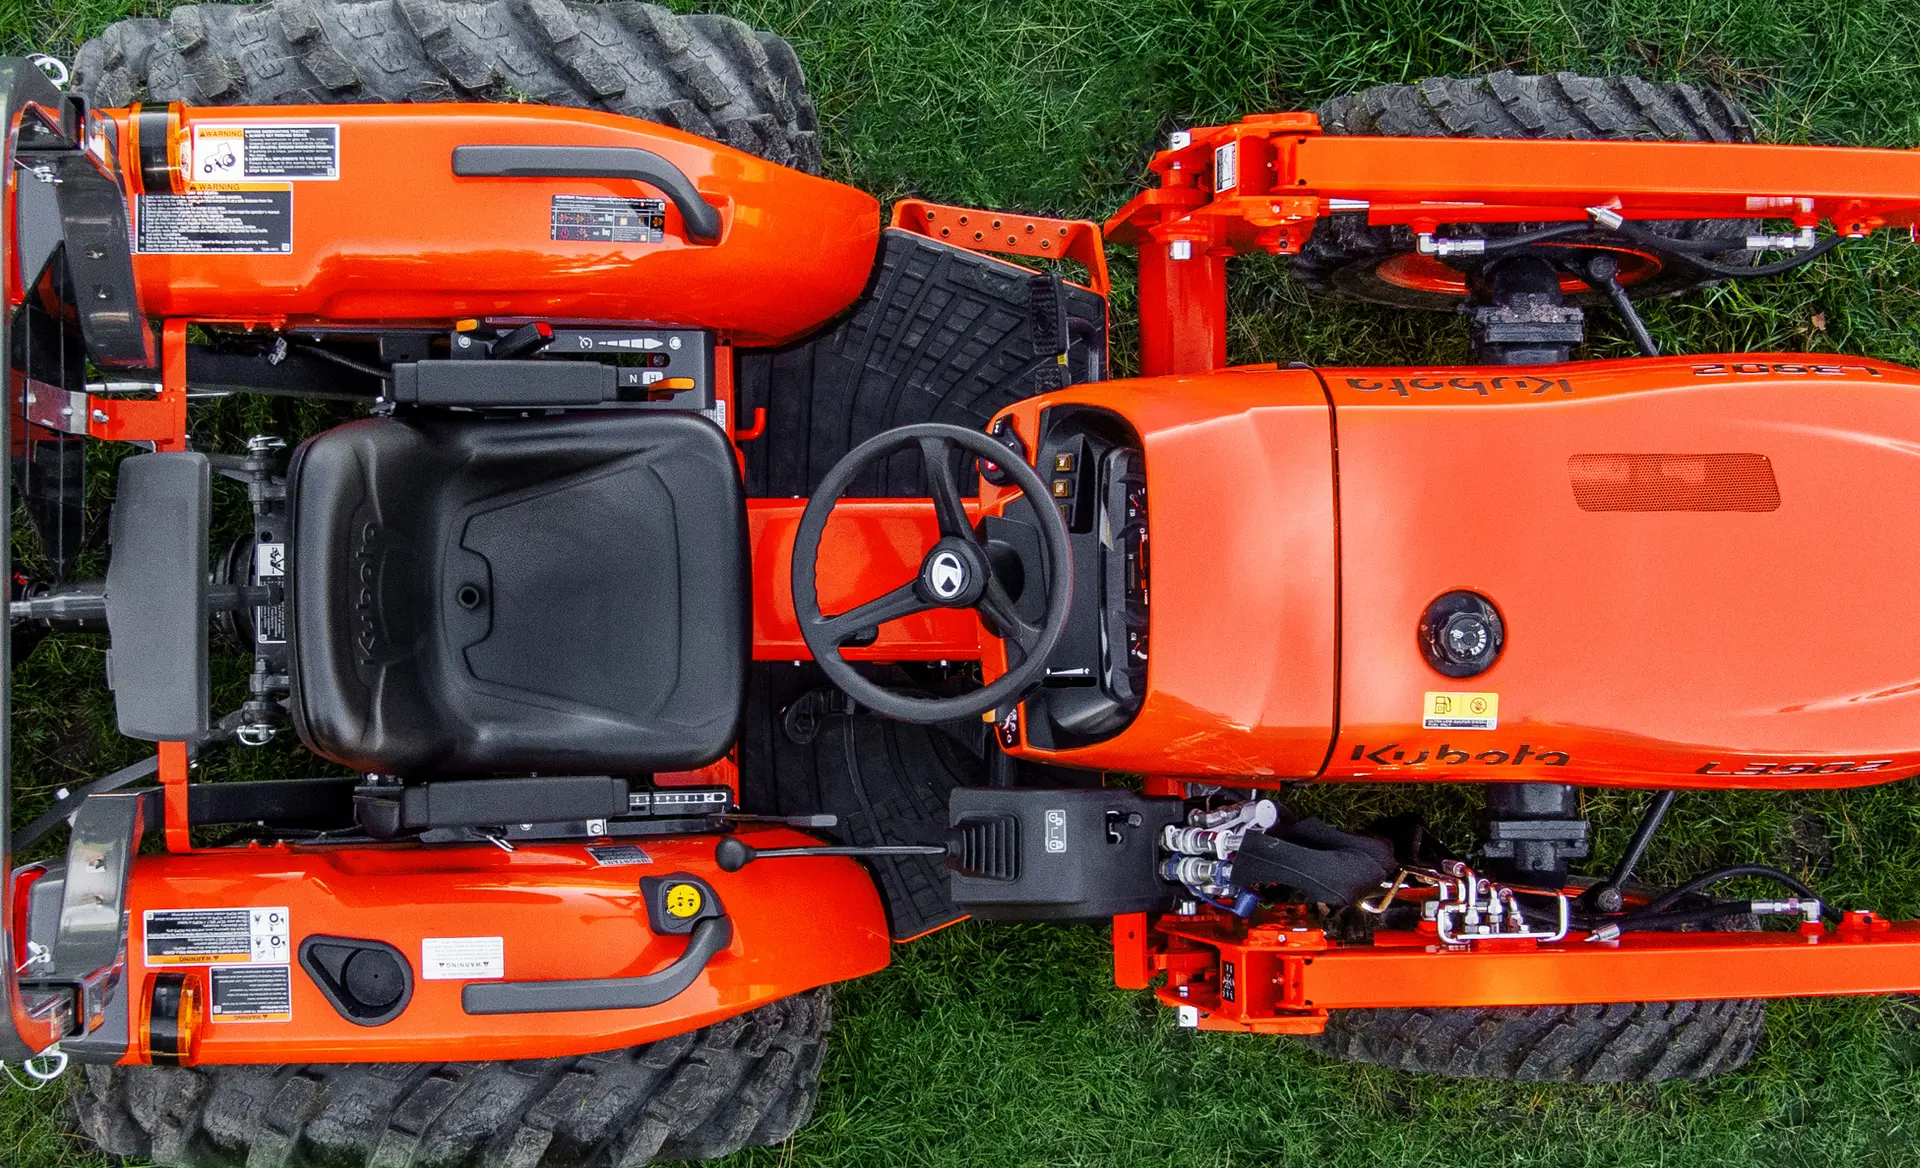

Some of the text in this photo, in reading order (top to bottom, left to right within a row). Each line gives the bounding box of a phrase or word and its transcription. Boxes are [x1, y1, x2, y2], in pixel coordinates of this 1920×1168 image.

[206, 128, 243, 137] WARNING
[199, 183, 240, 191] WARNING
[629, 374, 657, 383] N H
[1345, 375, 1574, 398] Kubota
[355, 522, 376, 665] Kubota
[1350, 744, 1570, 766] Kubota
[1695, 760, 1893, 775] L3902
